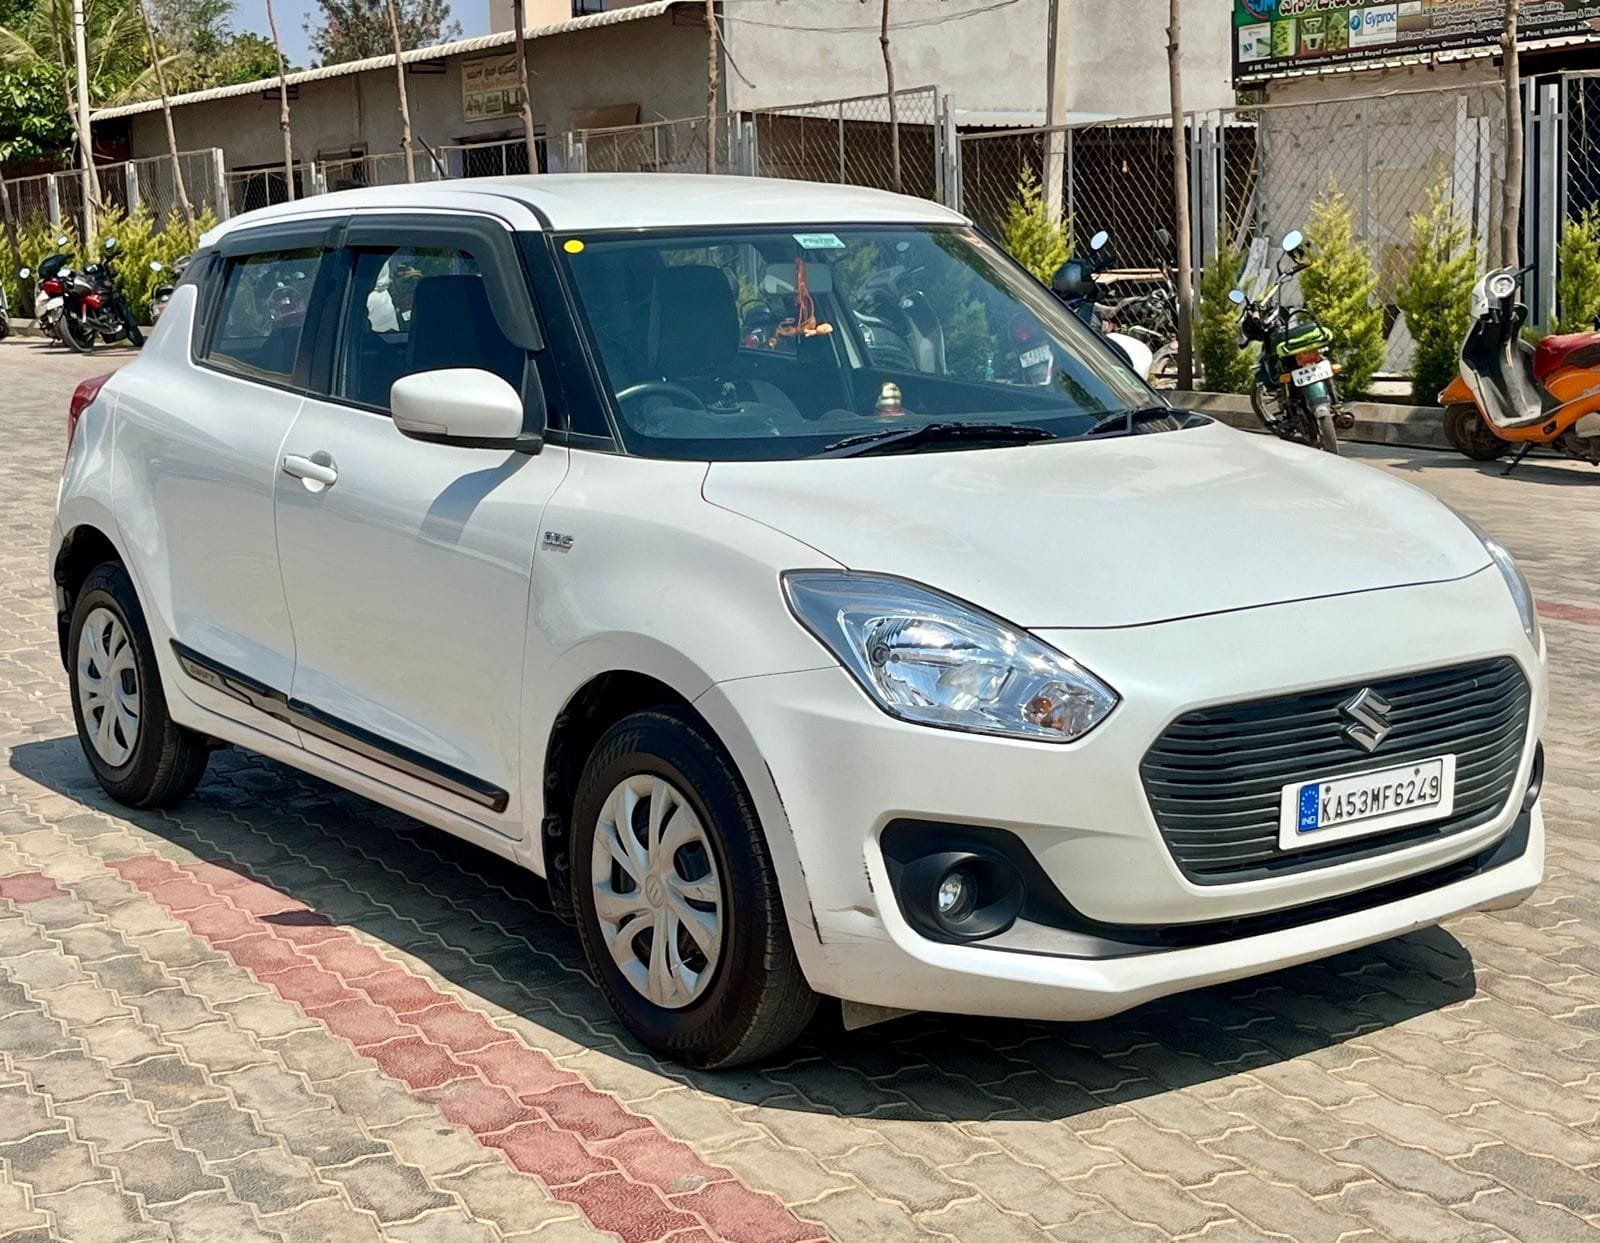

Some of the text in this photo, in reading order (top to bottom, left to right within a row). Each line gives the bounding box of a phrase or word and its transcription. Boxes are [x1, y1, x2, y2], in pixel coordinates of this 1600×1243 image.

[1457, 3, 1475, 11] False
[1365, 11, 1396, 28] Gyproc
[1441, 39, 1465, 47] Ground
[1302, 775, 1440, 826] IND KA53MF6249
